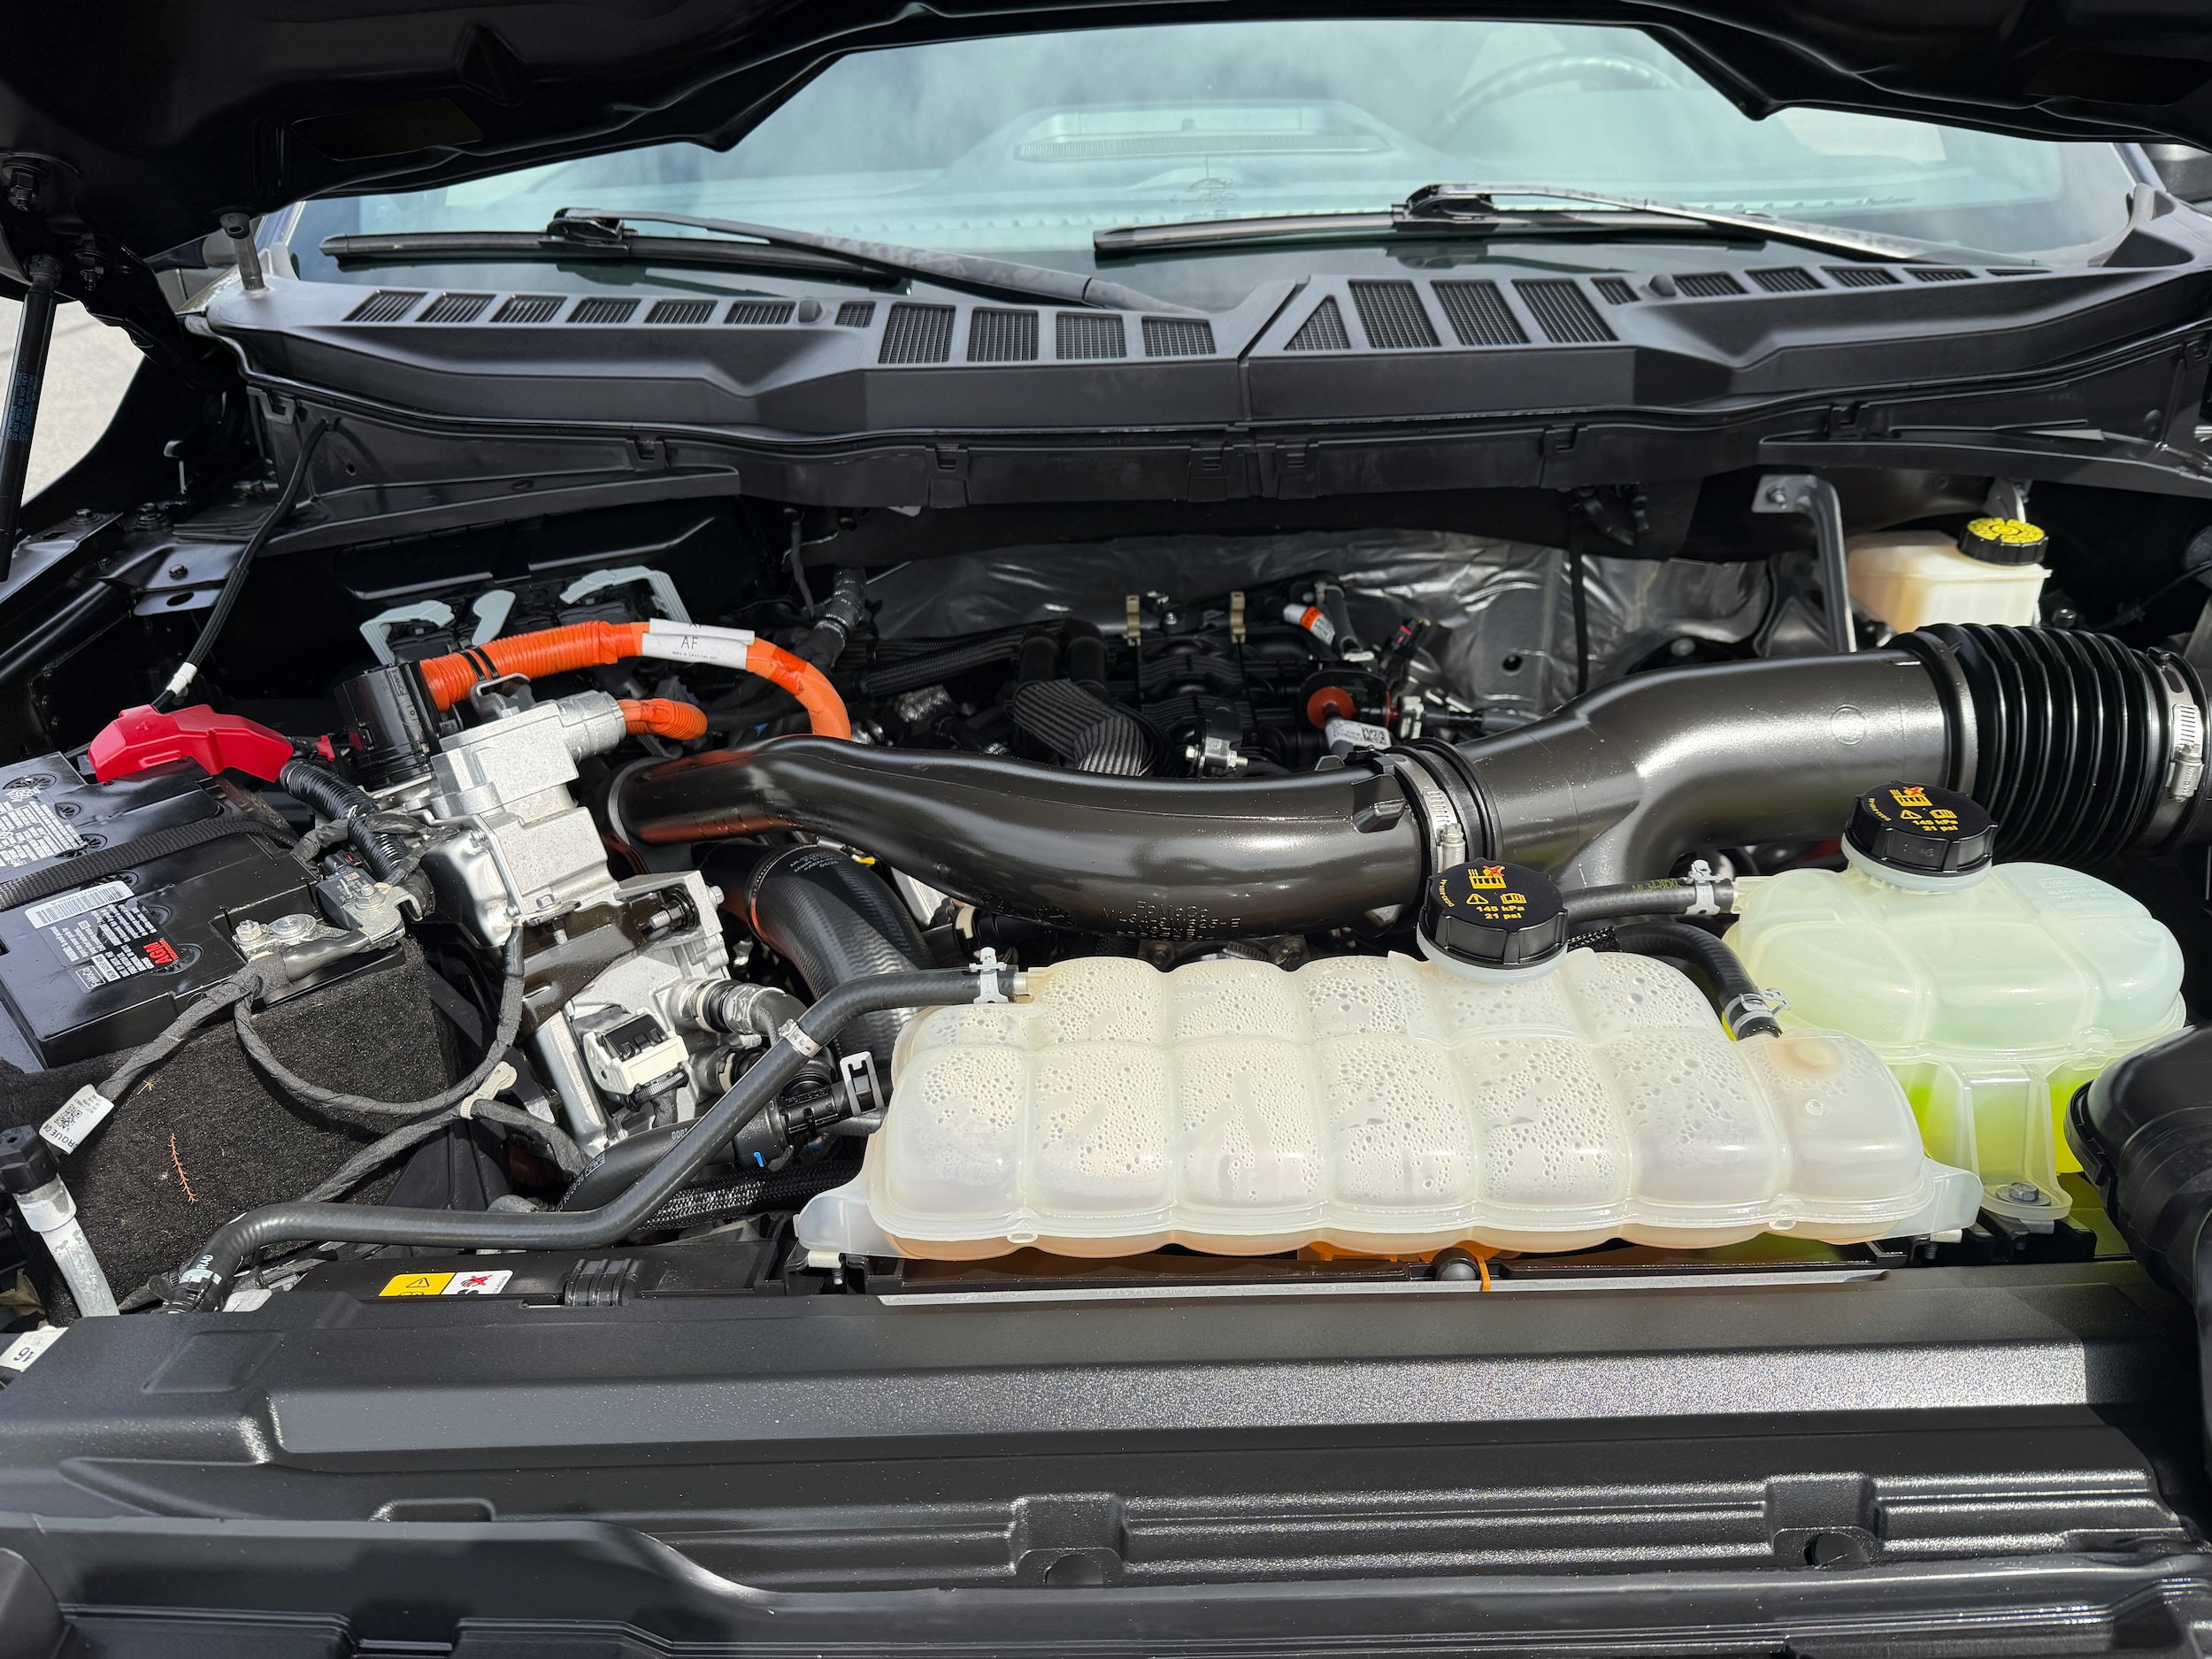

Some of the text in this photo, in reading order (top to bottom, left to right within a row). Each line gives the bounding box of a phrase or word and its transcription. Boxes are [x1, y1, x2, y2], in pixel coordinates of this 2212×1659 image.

[680, 636, 699, 649] AF
[142, 941, 173, 966] AGM
[82, 967, 104, 987] FoMoCo
[196, 1254, 214, 1270] RAD
